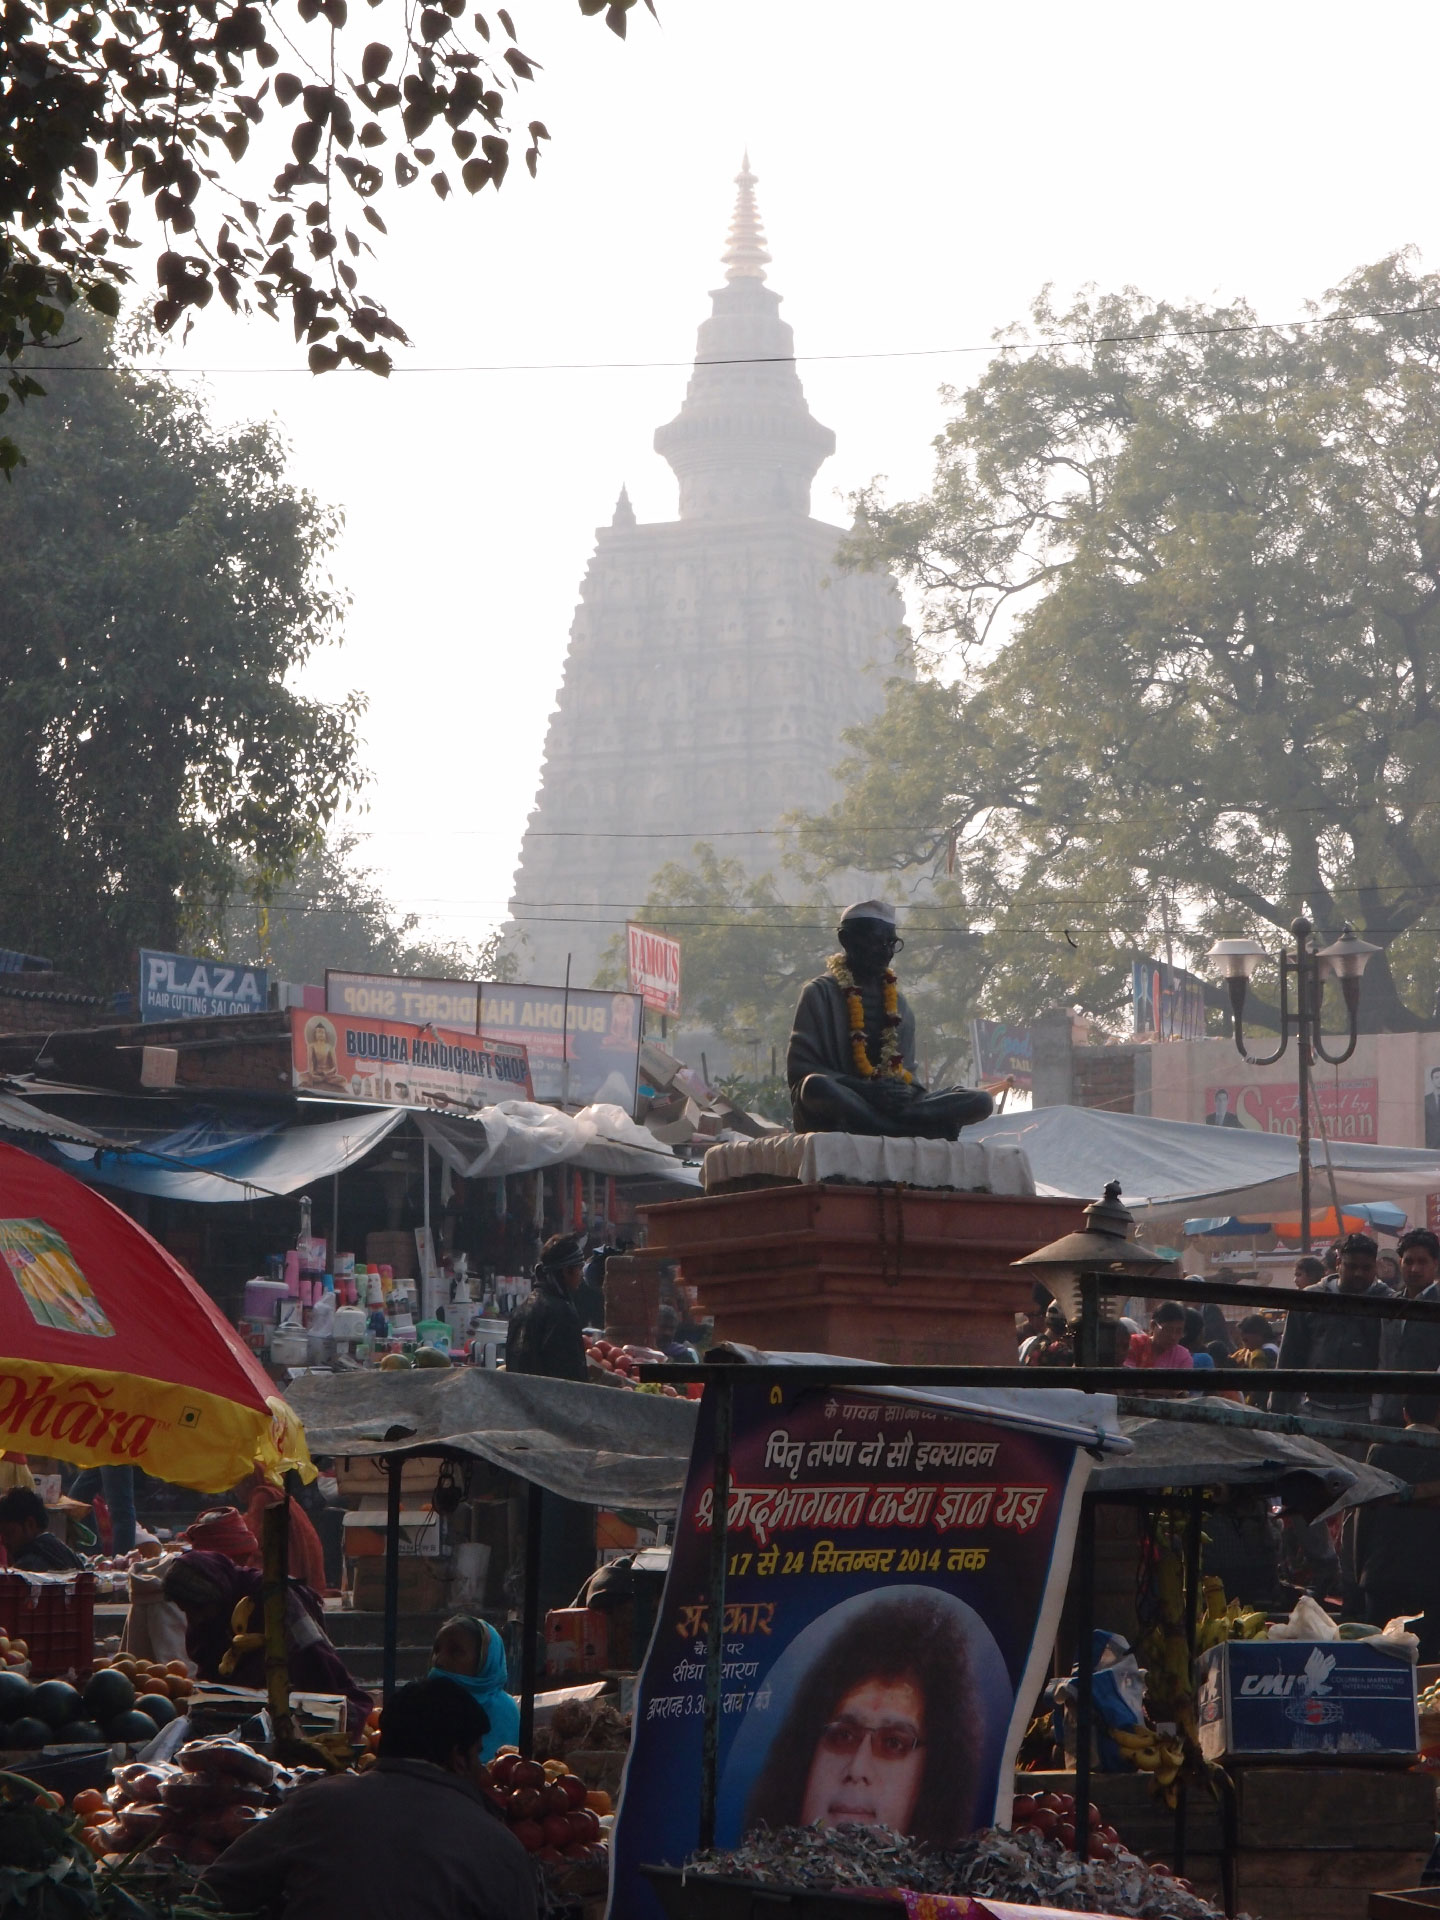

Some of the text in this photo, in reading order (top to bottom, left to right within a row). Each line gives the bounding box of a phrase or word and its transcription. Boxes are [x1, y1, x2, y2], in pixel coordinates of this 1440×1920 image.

[631, 930, 679, 985] FAMOUS
[148, 958, 262, 1002] PLAZA
[148, 991, 170, 1008] HAIR
[172, 995, 207, 1015] CUTTING
[346, 1029, 529, 1083] BUDDHA HANDICRAFT SHOP
[1352, 1094, 1370, 1111] by
[824, 1398, 839, 1420] के
[842, 1405, 883, 1422] पावन
[764, 1429, 1001, 1481] पितृ तर्पण दो सौ इक्यावन
[868, 1486, 932, 1529] कथा
[934, 1487, 989, 1532] ज्ञान
[995, 1487, 1048, 1532] यज्ञ
[729, 1541, 990, 1576] 17 से 24 सितम्बर 2014 तक
[672, 1658, 706, 1683] सीधा
[1366, 1677, 1406, 1686] MARKETING
[1240, 1674, 1296, 1696] CMI
[1341, 1683, 1395, 1691] INTERNATIONAL
